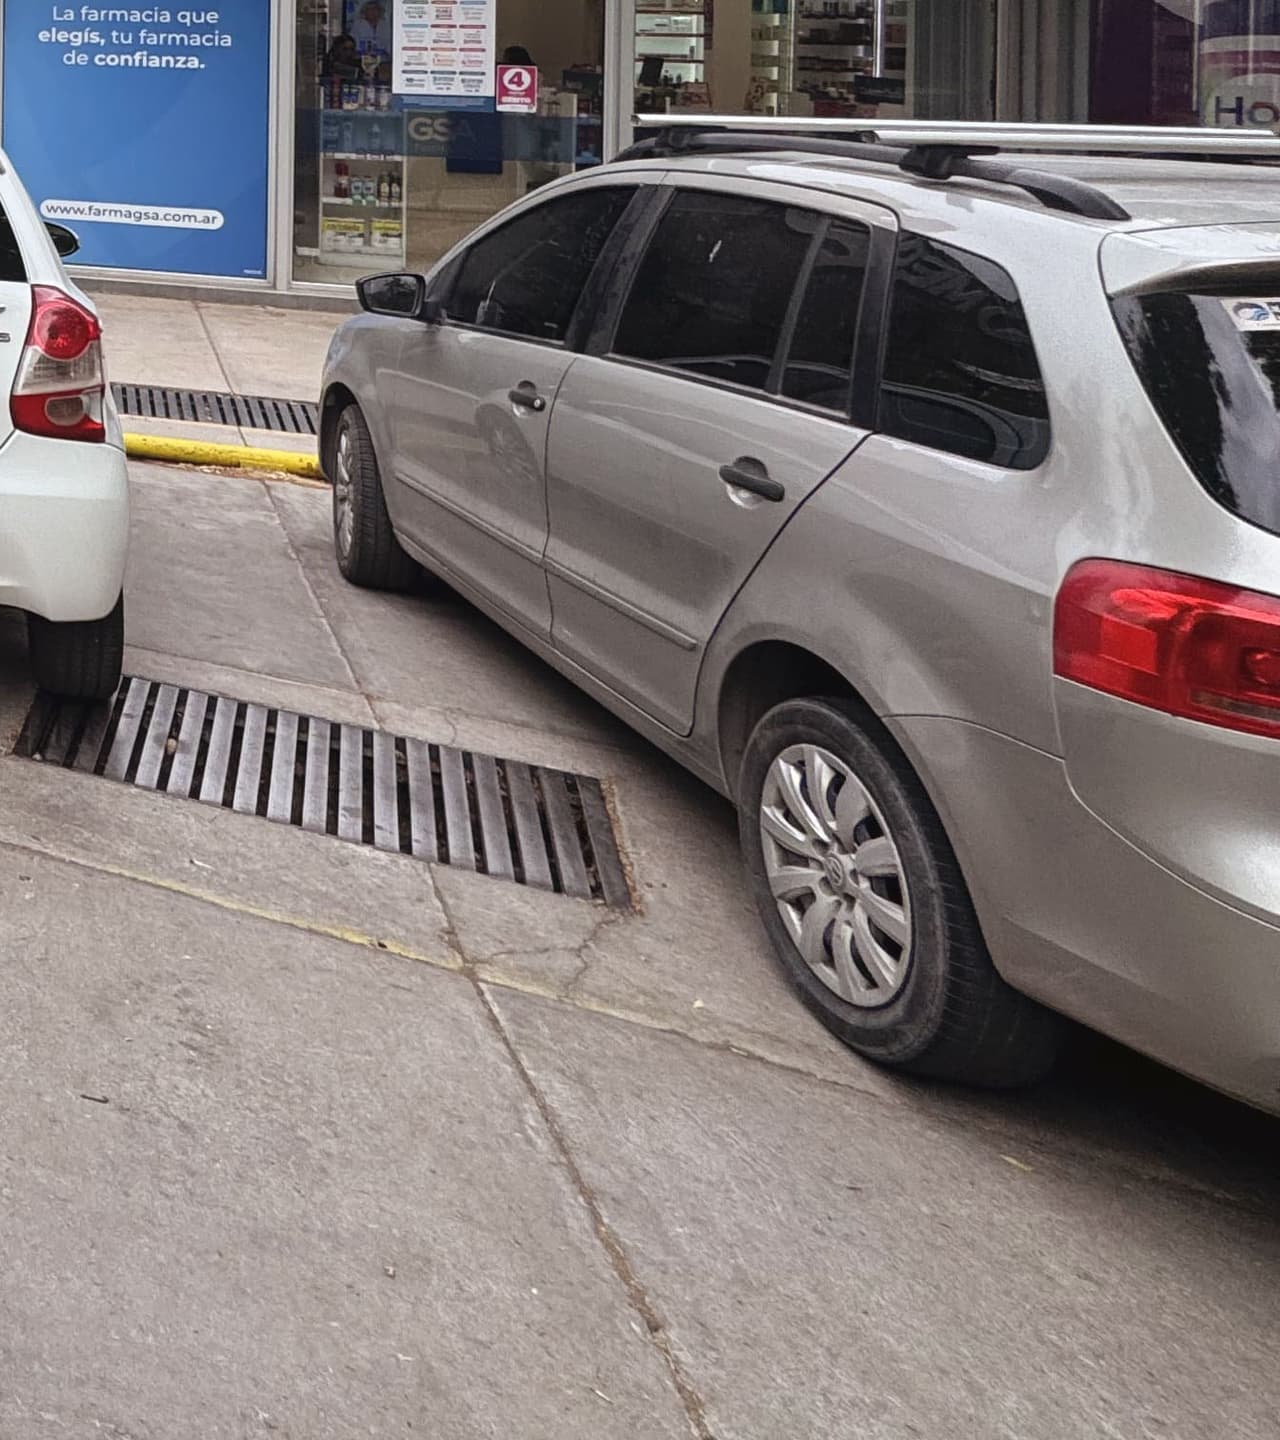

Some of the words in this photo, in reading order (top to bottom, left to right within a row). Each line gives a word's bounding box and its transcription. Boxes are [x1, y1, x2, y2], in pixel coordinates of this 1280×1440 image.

[52, 6, 75, 21] La
[80, 6, 171, 23] farmacia
[177, 10, 220, 26] que
[111, 30, 133, 45] tu
[139, 29, 232, 47] farmacia
[62, 49, 89, 66] de
[93, 51, 206, 69] confianza.
[507, 71, 525, 88] 4
[45, 203, 219, 226] www.farmagsa.com.ar
